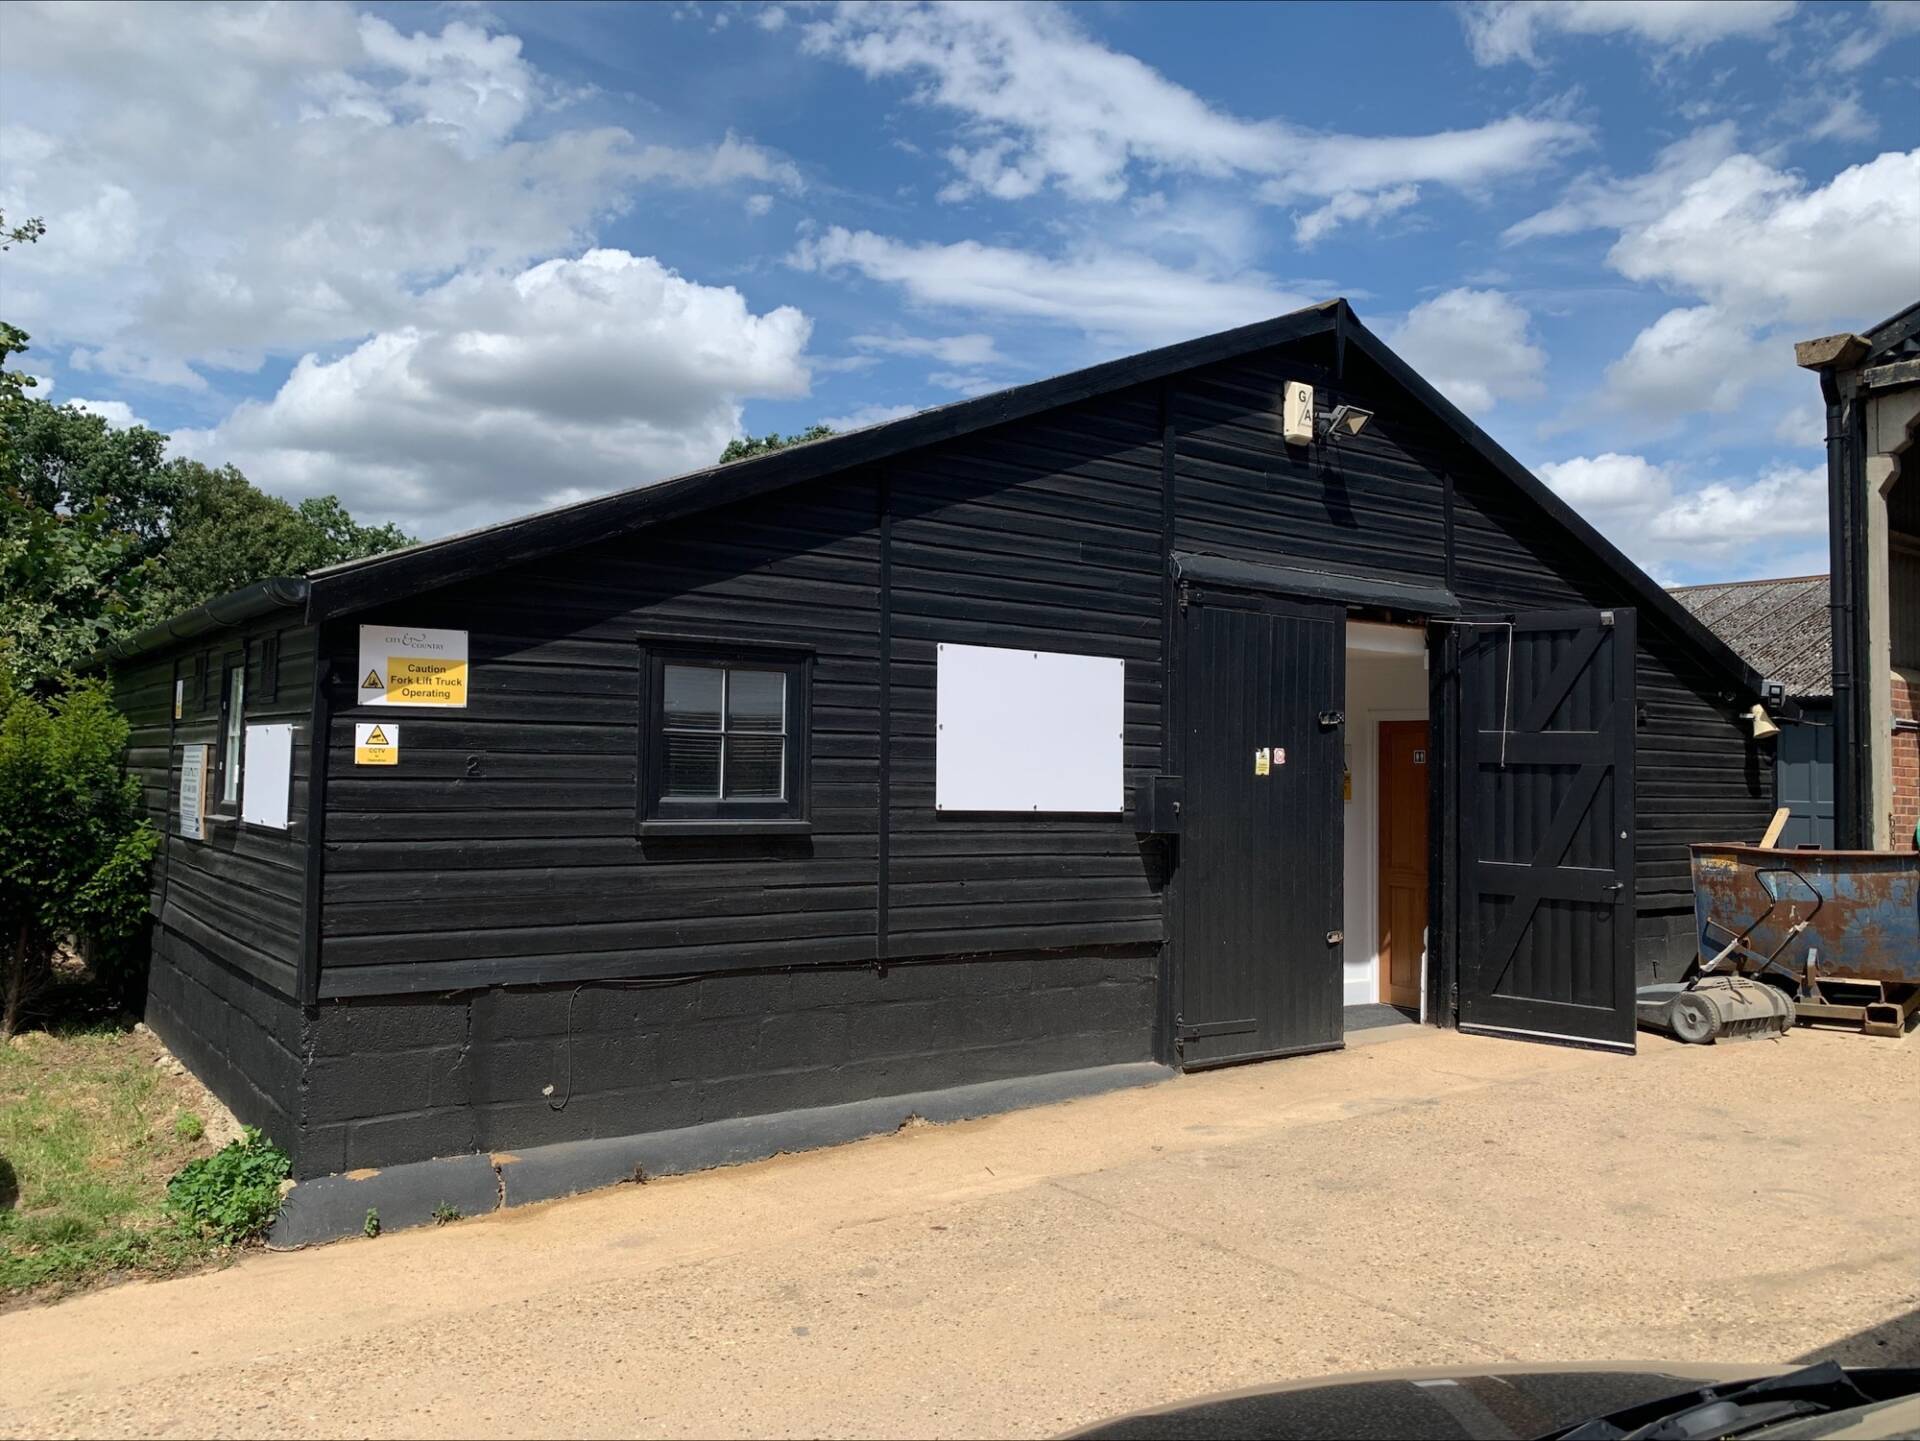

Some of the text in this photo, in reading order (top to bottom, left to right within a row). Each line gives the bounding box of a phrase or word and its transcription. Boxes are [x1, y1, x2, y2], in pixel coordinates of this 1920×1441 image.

[1299, 390, 1306, 402] G
[1304, 409, 1311, 421] A
[408, 664, 446, 673] Caution
[390, 675, 462, 686] Fork Lift Truck
[402, 688, 450, 699] Operating
